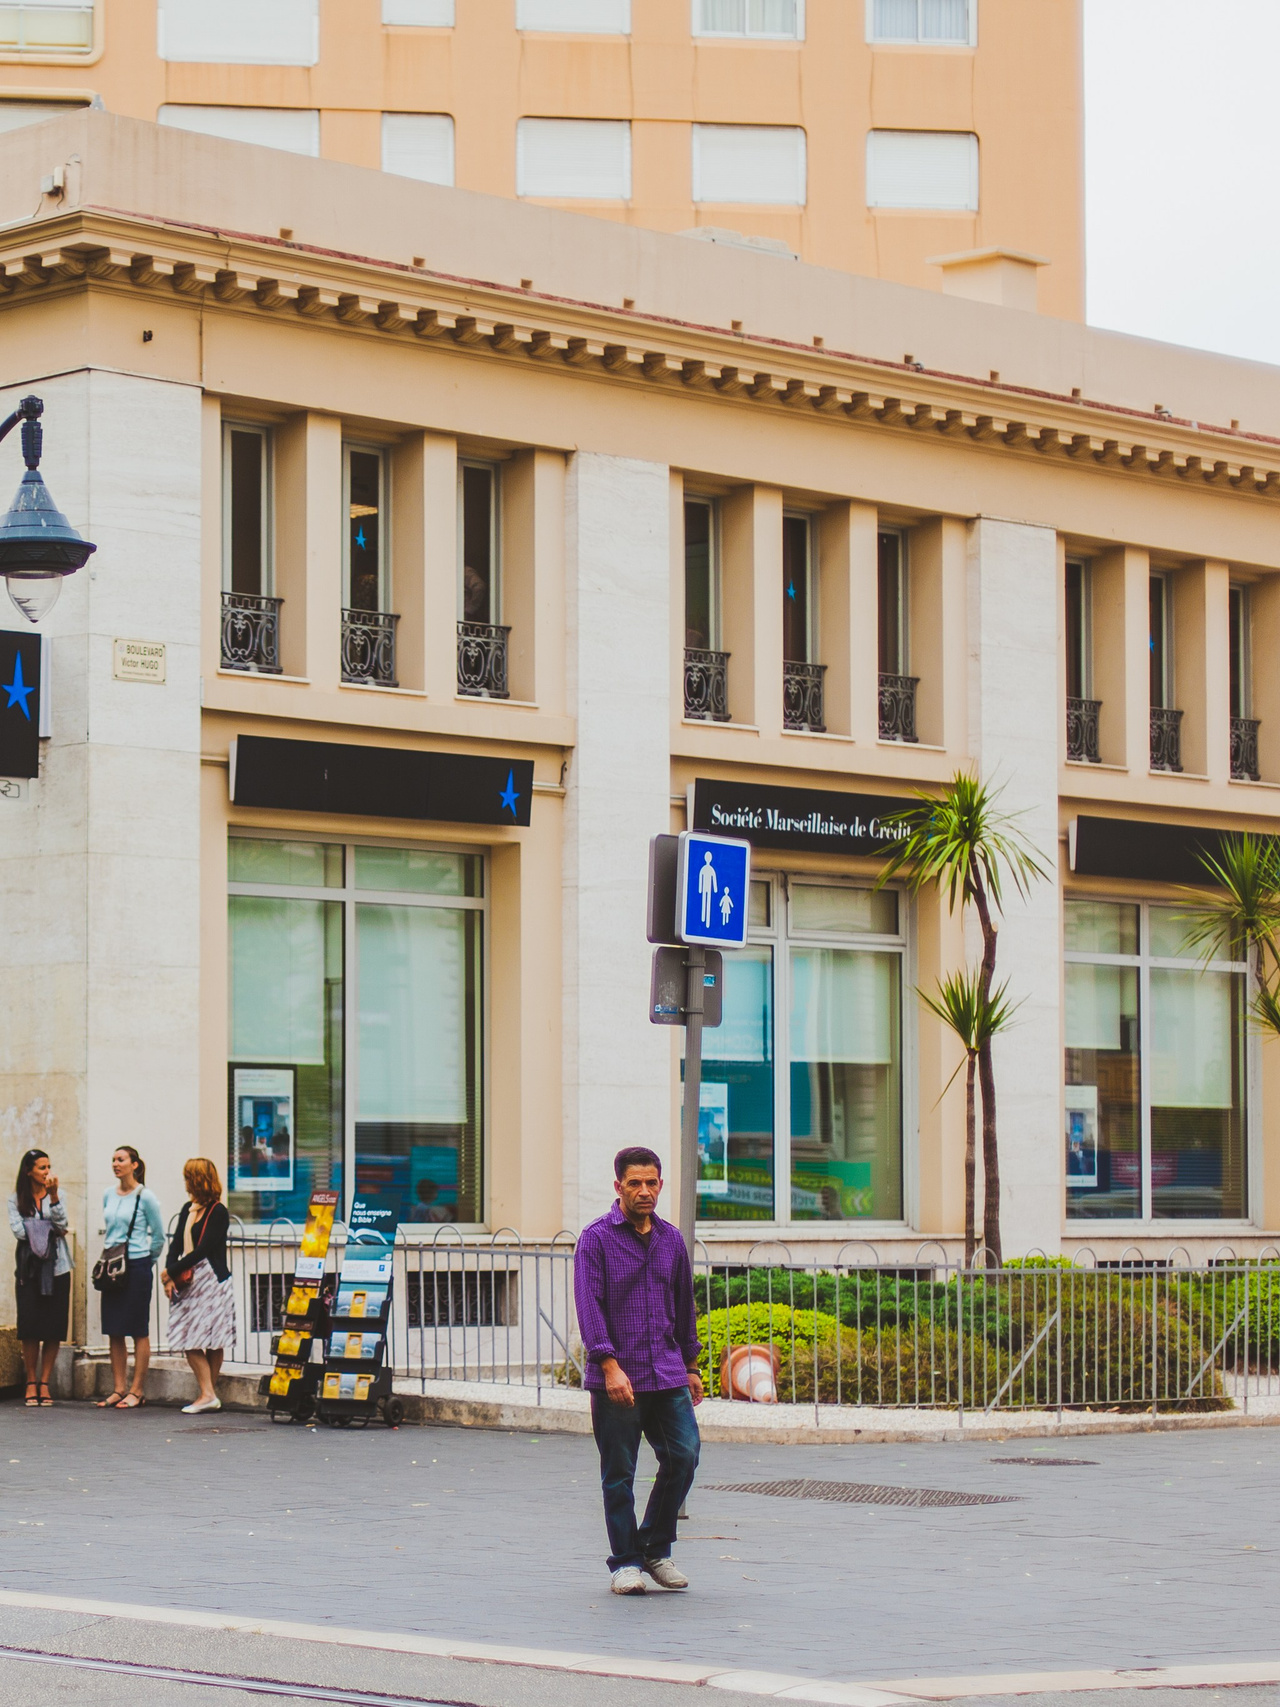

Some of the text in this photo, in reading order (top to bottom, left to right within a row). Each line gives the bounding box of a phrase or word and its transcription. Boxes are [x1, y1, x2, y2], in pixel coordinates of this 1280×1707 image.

[126, 645, 163, 657] BOULEVARD
[140, 659, 159, 670] HUGO
[711, 803, 762, 829] Société
[765, 808, 847, 836] Marseillaise
[850, 816, 867, 837] de
[354, 1201, 366, 1209] Que
[367, 1209, 392, 1218] enseigne
